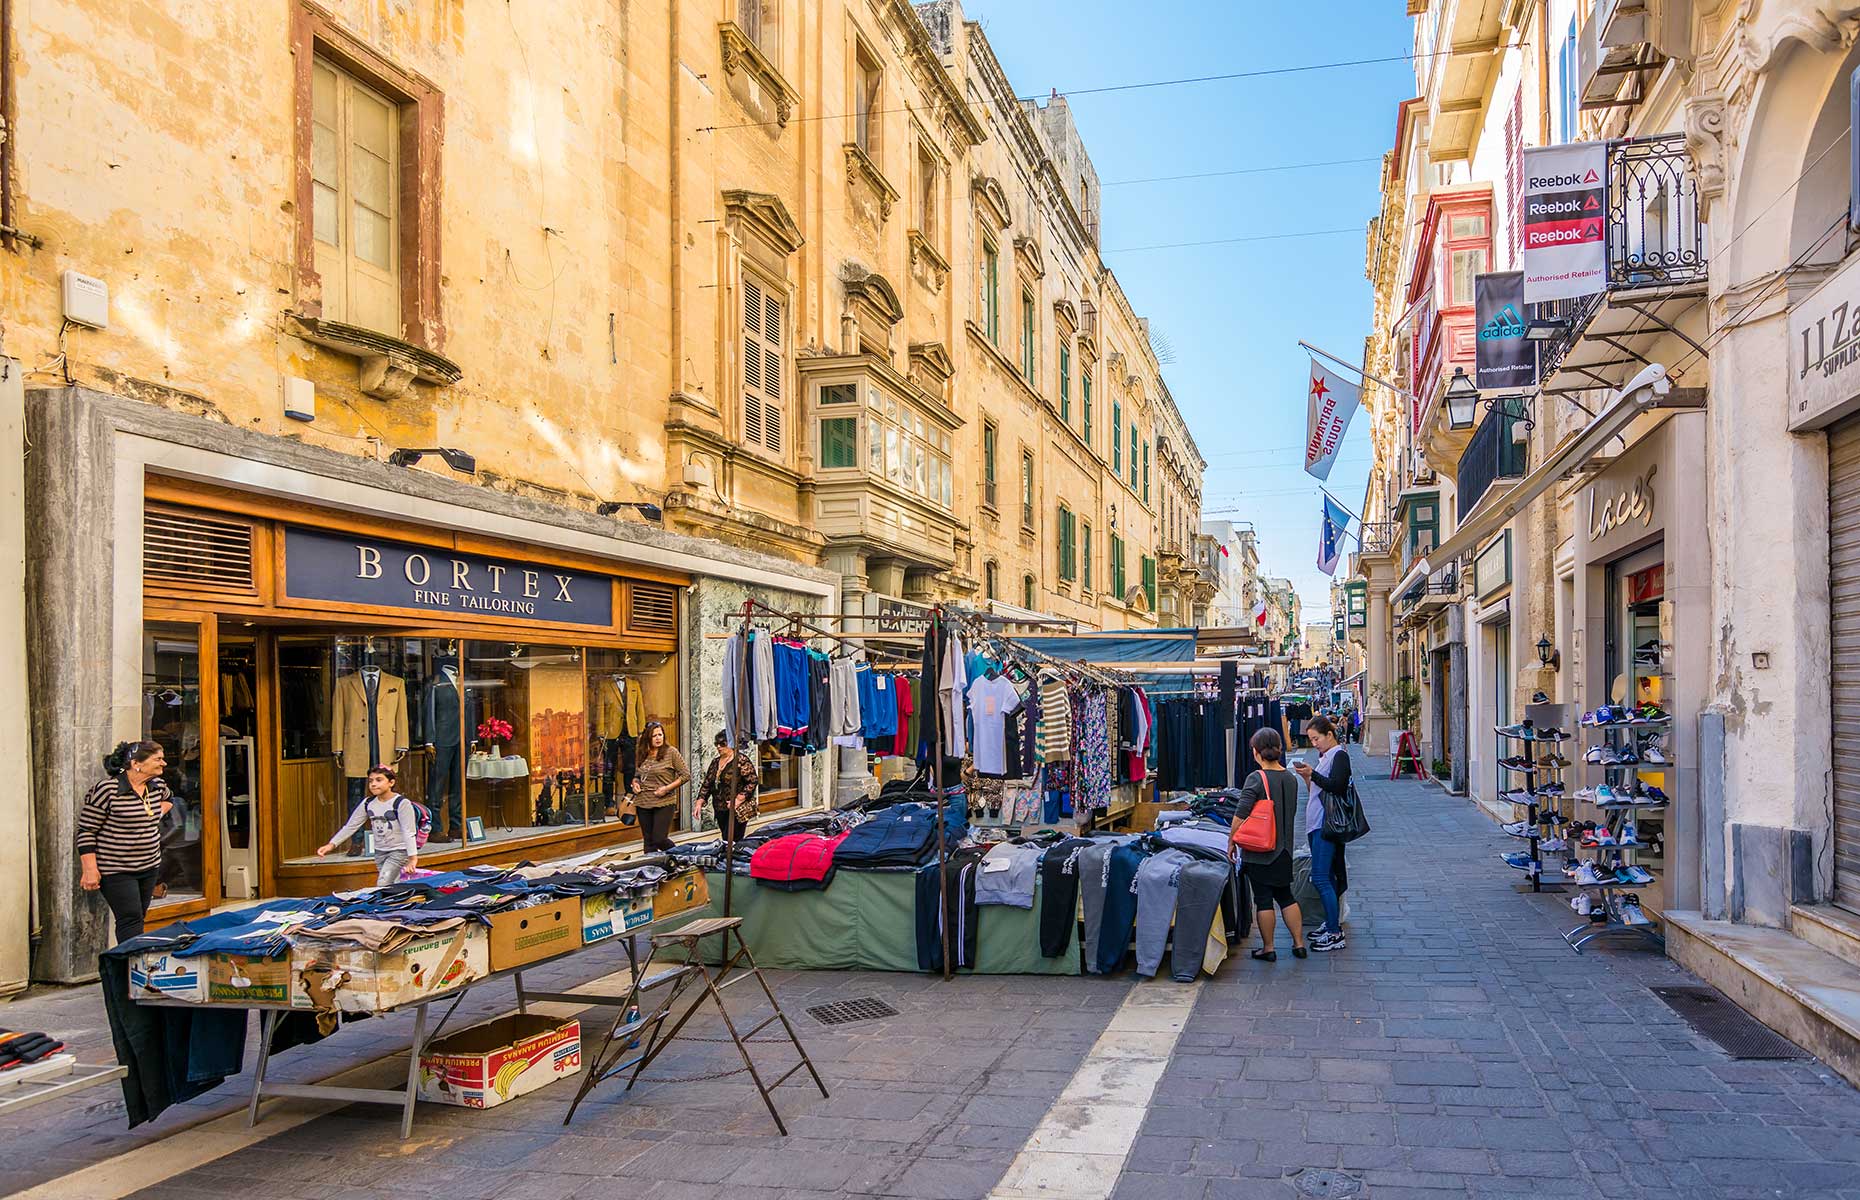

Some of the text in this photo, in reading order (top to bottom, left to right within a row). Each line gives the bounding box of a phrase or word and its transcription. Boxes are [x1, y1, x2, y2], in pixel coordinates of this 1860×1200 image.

[1529, 173, 1581, 189] Reebok
[1529, 200, 1581, 216] Reebok
[1529, 228, 1581, 244] Reebok
[1526, 269, 1602, 283] Authorised Retailer
[1482, 324, 1526, 339] adidas
[1479, 363, 1533, 374] Authorised Retailer
[1588, 463, 1658, 542] Laces
[355, 545, 574, 602] BORTEX
[414, 589, 535, 615] FINE TAILORING
[403, 930, 473, 956] Prum Bananas
[502, 1030, 569, 1061] PREMIUM BANANAS
[445, 1058, 480, 1067] PREMIUM
[553, 1051, 580, 1072] Dole
